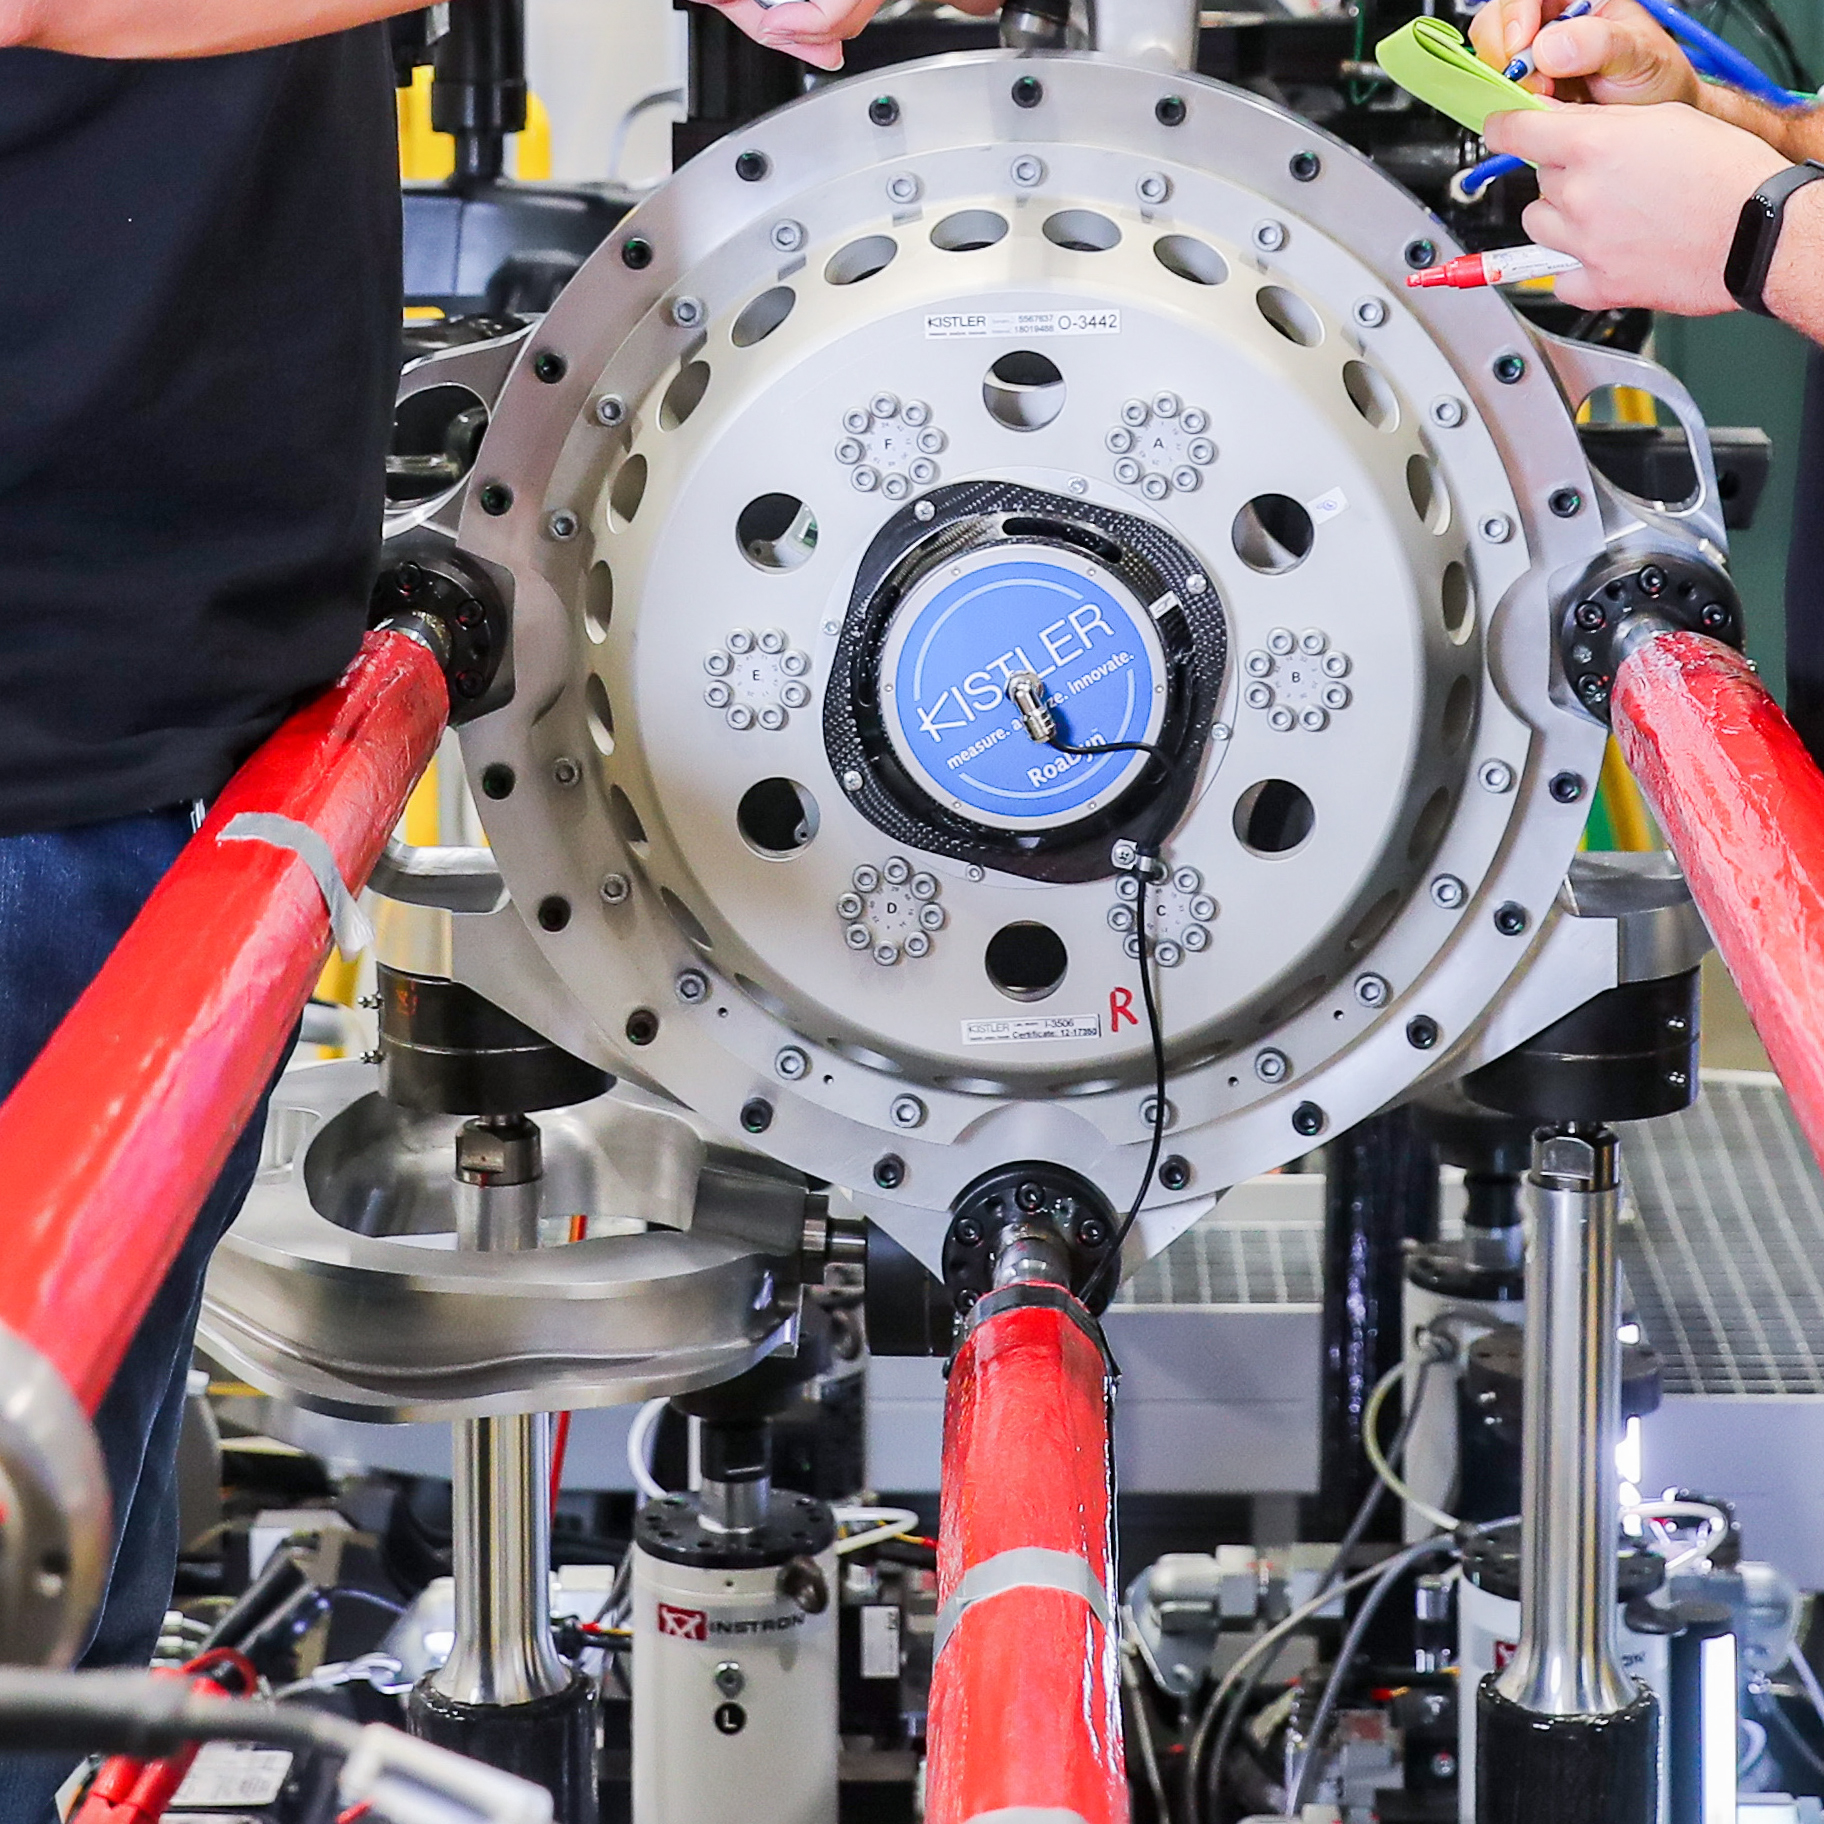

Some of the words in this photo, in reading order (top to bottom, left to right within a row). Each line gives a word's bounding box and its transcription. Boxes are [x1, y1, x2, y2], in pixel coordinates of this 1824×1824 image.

[928, 315, 987, 328] KISTLER
[1058, 313, 1118, 330] O-3442
[884, 438, 893, 450] F
[1153, 437, 1164, 449] A
[752, 669, 760, 681] E
[917, 602, 1115, 743] KISTLER
[1291, 671, 1301, 683] B
[946, 726, 1012, 771] measure.
[1067, 649, 1136, 696] innovate.
[887, 902, 897, 914] D
[1156, 904, 1166, 917] C
[1109, 986, 1139, 1033] R
[968, 1022, 1010, 1033] KISTLER
[709, 1613, 806, 1634] INSTRON
[724, 1708, 738, 1728] L
